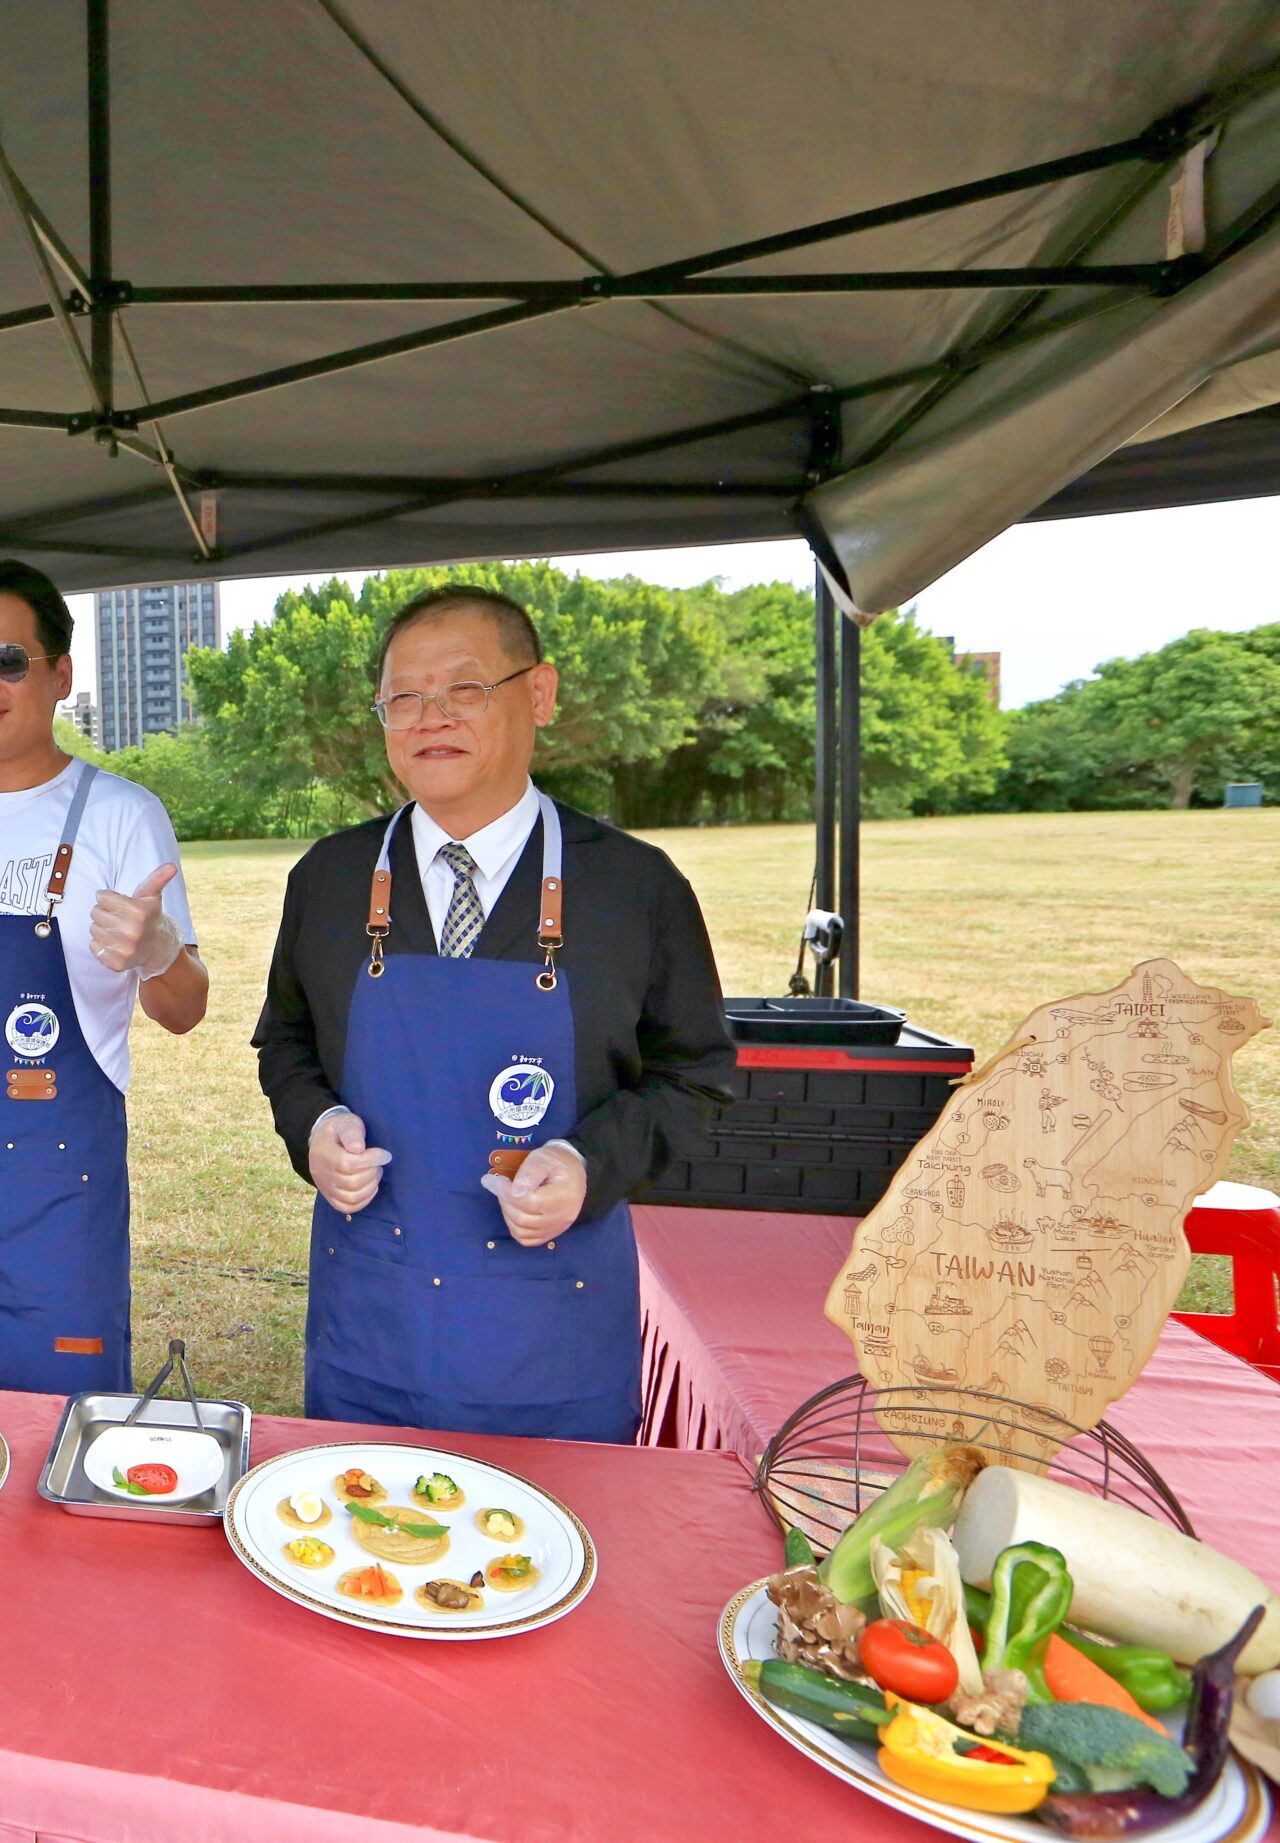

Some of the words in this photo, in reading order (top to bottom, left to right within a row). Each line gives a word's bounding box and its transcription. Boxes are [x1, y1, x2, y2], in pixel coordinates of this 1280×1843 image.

[1115, 1002, 1166, 1017] TAIPEI
[1059, 1055, 1067, 1063] 3
[917, 1159, 971, 1177] Taichung
[905, 1188, 941, 1198] CHANGHUA
[1054, 1228, 1077, 1236] Moon
[929, 1251, 1036, 1287] TAIWAN
[1041, 1267, 1072, 1277] Yushan
[1038, 1274, 1075, 1284] National
[1046, 1281, 1068, 1290] Park
[850, 1316, 890, 1337] Tainan
